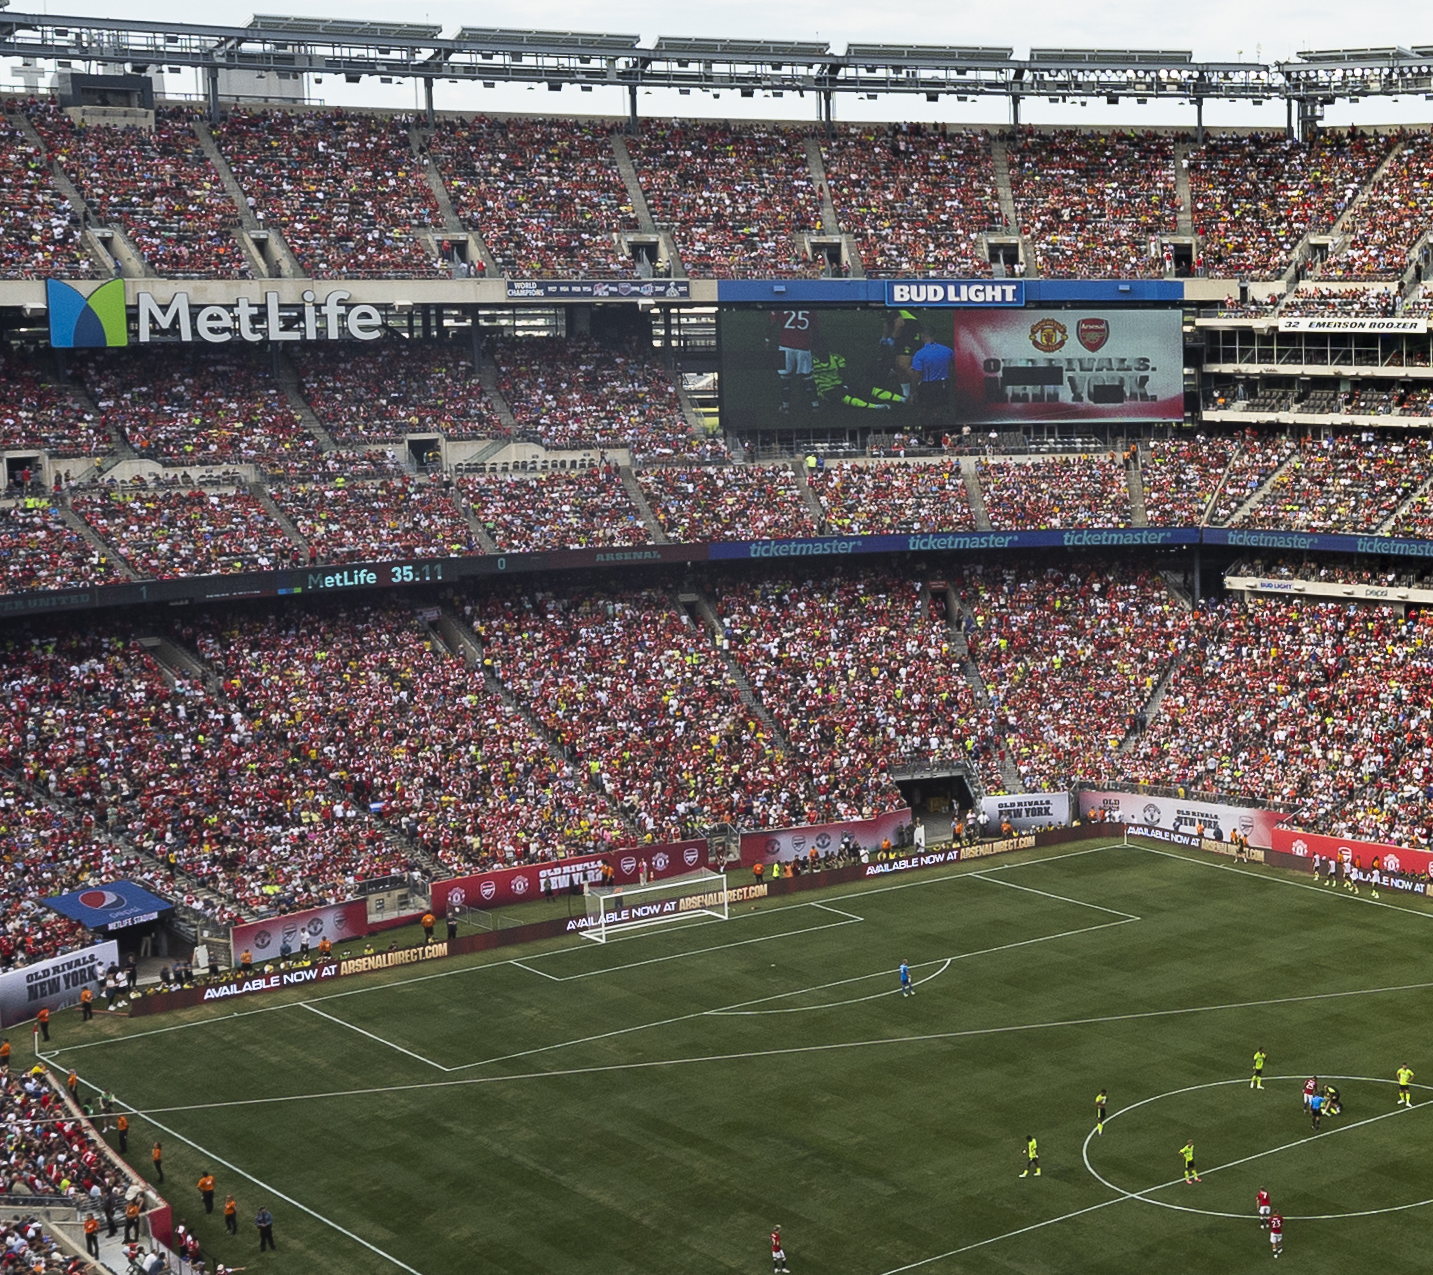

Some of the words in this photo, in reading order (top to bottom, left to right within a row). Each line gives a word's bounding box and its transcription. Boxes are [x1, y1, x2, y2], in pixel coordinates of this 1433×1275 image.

[507, 289, 545, 297] CHAMPIONS
[893, 285, 944, 302] BUD
[947, 285, 1016, 302] LIGHT
[137, 290, 383, 343] MetLife
[783, 311, 809, 330] 25
[1284, 321, 1300, 329] 32
[1308, 321, 1365, 330] EMERSON
[1368, 322, 1418, 330] BOOZER
[908, 534, 1013, 551] ticketmaster
[1063, 530, 1167, 546] ticketmaster
[1227, 531, 1314, 549] ticketmaster
[595, 551, 662, 562] ARSENAL
[749, 539, 856, 558] ticketmaster
[307, 569, 377, 588] MetLife
[391, 564, 442, 583] 35:11
[998, 801, 1016, 809] OLD
[1102, 798, 1119, 806] OLD
[1024, 806, 1053, 818] YORK.
[1197, 817, 1220, 829] YORK.
[1127, 825, 1169, 842] AVAILABLE
[1170, 833, 1191, 845] NOW
[1191, 838, 1201, 846] AT
[866, 857, 918, 875] AVAILABLE
[920, 852, 945, 866] NOW
[946, 850, 959, 861] AT
[539, 867, 563, 879] OLD
[1390, 878, 1413, 891] NOW
[1414, 883, 1425, 893] AT
[631, 904, 662, 918] NOW
[663, 900, 677, 912] AT
[108, 918, 133, 931] METLIFE
[26, 968, 51, 983] OLD
[51, 953, 99, 975] RIVALS.
[203, 975, 280, 1001] AVAILABLE
[283, 968, 318, 986] NOW
[321, 964, 338, 977] AT
[340, 942, 448, 976] ARSENALDIRECT.COM
[27, 975, 61, 1002] NEW
